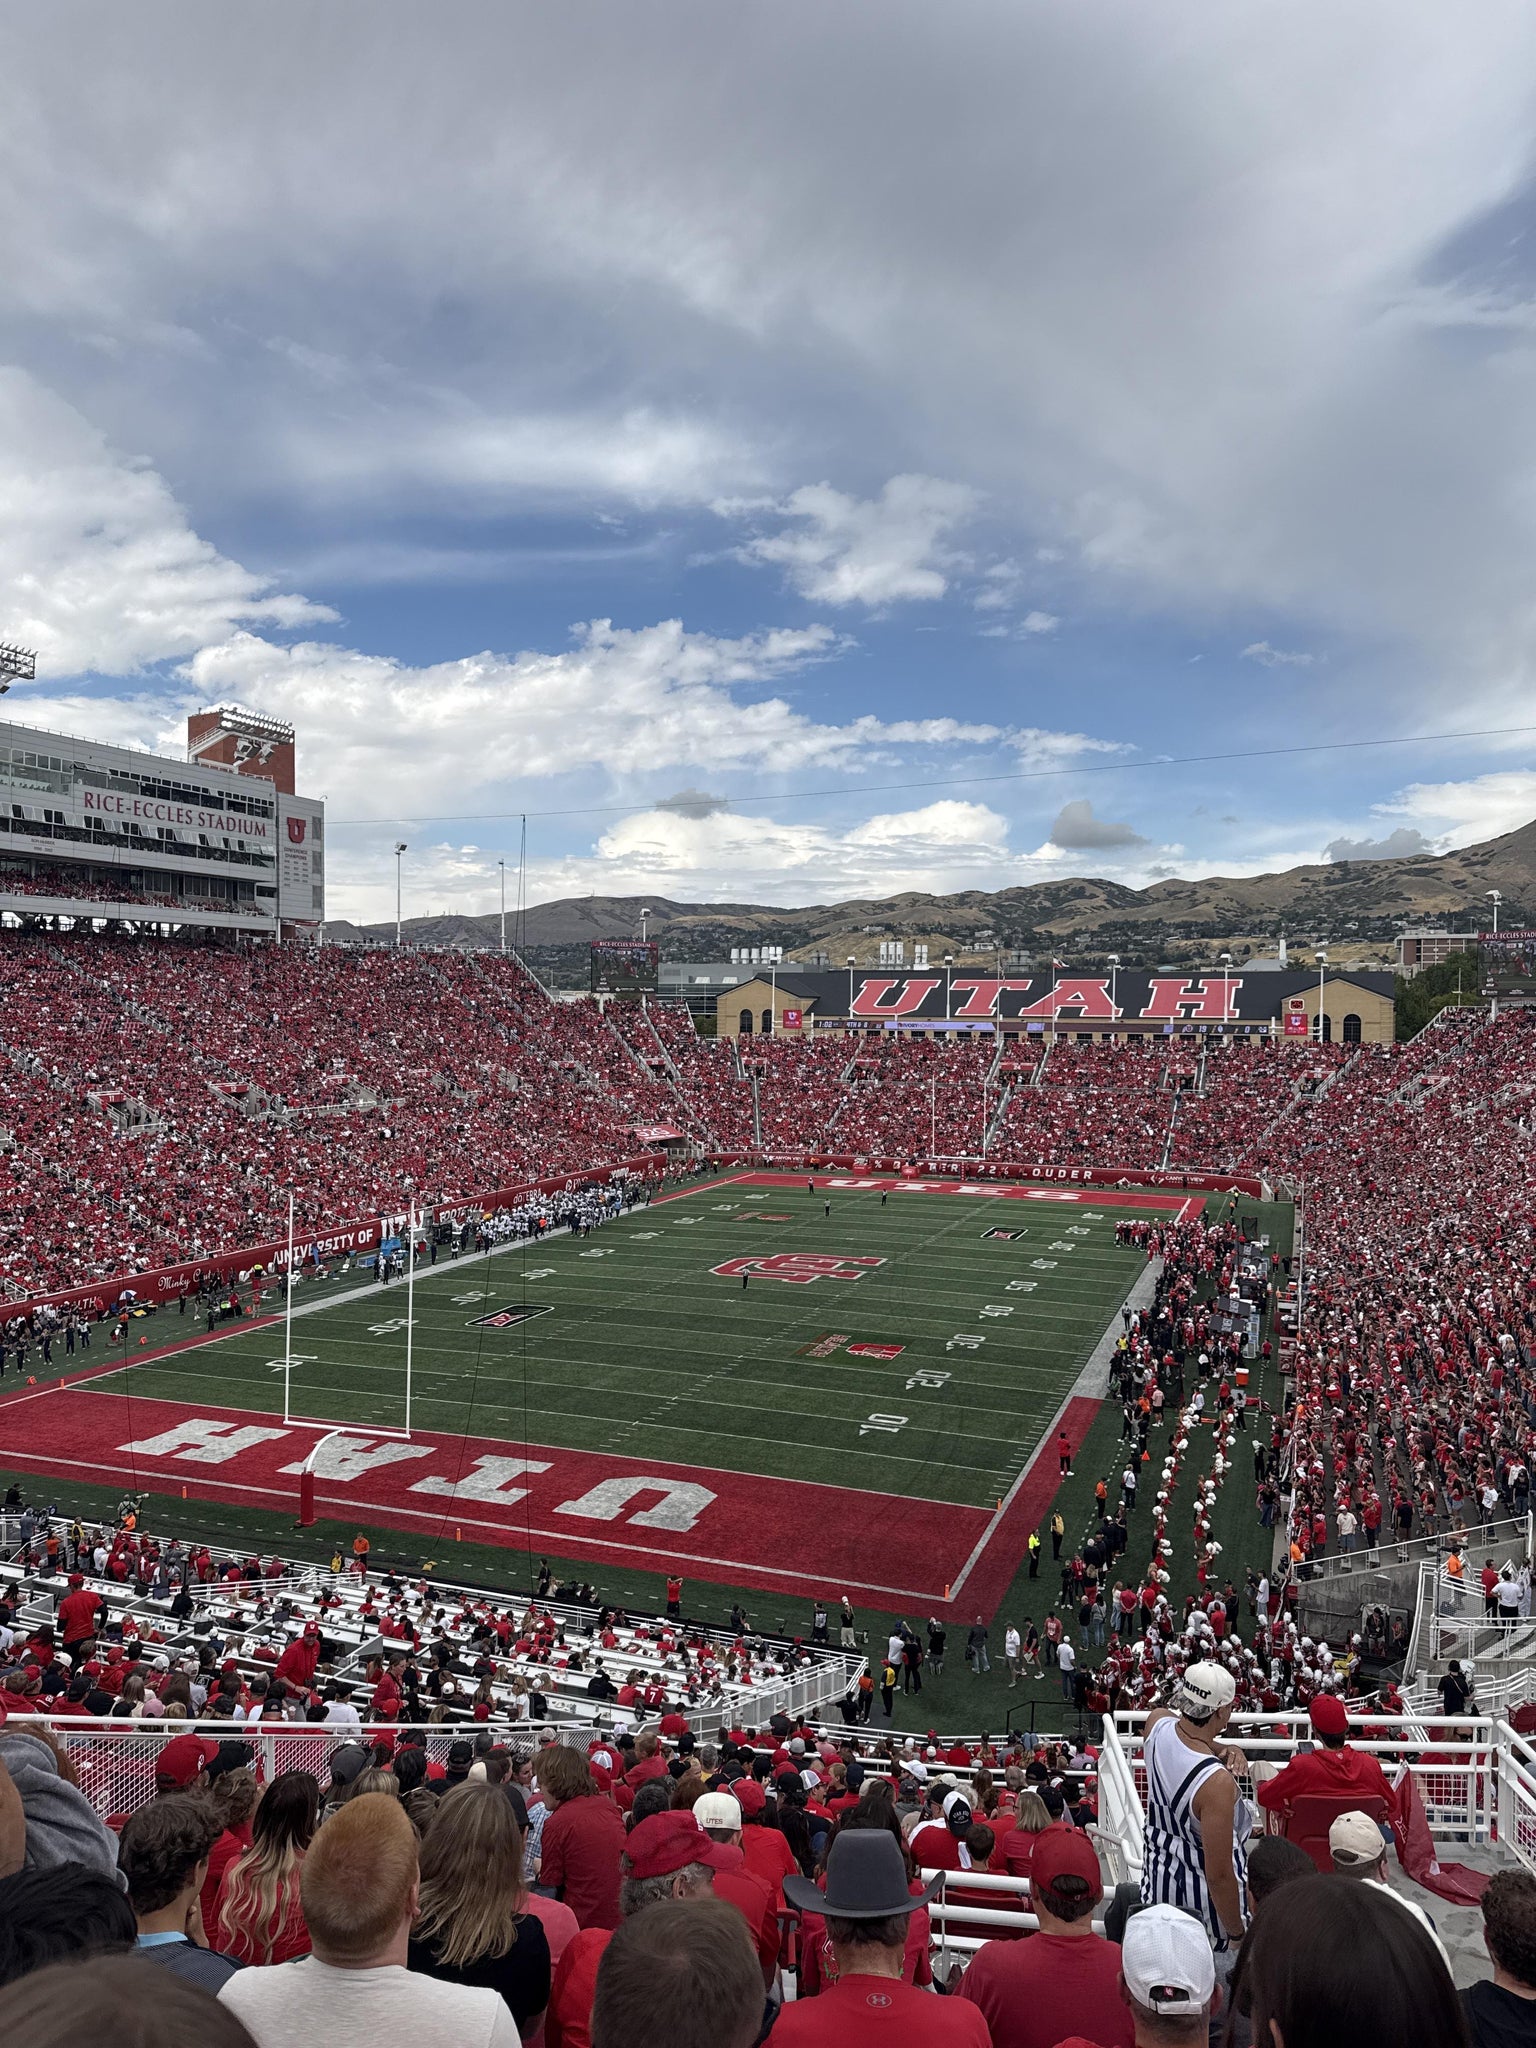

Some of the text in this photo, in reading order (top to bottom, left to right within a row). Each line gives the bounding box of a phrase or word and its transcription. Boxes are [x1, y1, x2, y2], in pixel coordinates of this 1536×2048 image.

[84, 792, 266, 837] RICE-ECCLES STADIUM
[287, 817, 306, 843] U
[848, 979, 1244, 1019] UTAH
[826, 1179, 1082, 1200] UTES
[358, 1229, 374, 1245] OF
[439, 1202, 485, 1222] FOOTLL
[158, 1274, 191, 1292] Minky
[1005, 1280, 1038, 1292] 50
[980, 1304, 1015, 1317] 40
[367, 1318, 420, 1333] 20
[946, 1333, 987, 1350] 30
[264, 1353, 319, 1368] 10
[905, 1368, 952, 1388] 20
[860, 1413, 909, 1433] 10
[115, 1418, 719, 1533] UTAH
[650, 1691, 656, 1703] 7
[706, 1817, 724, 1825] UTES
